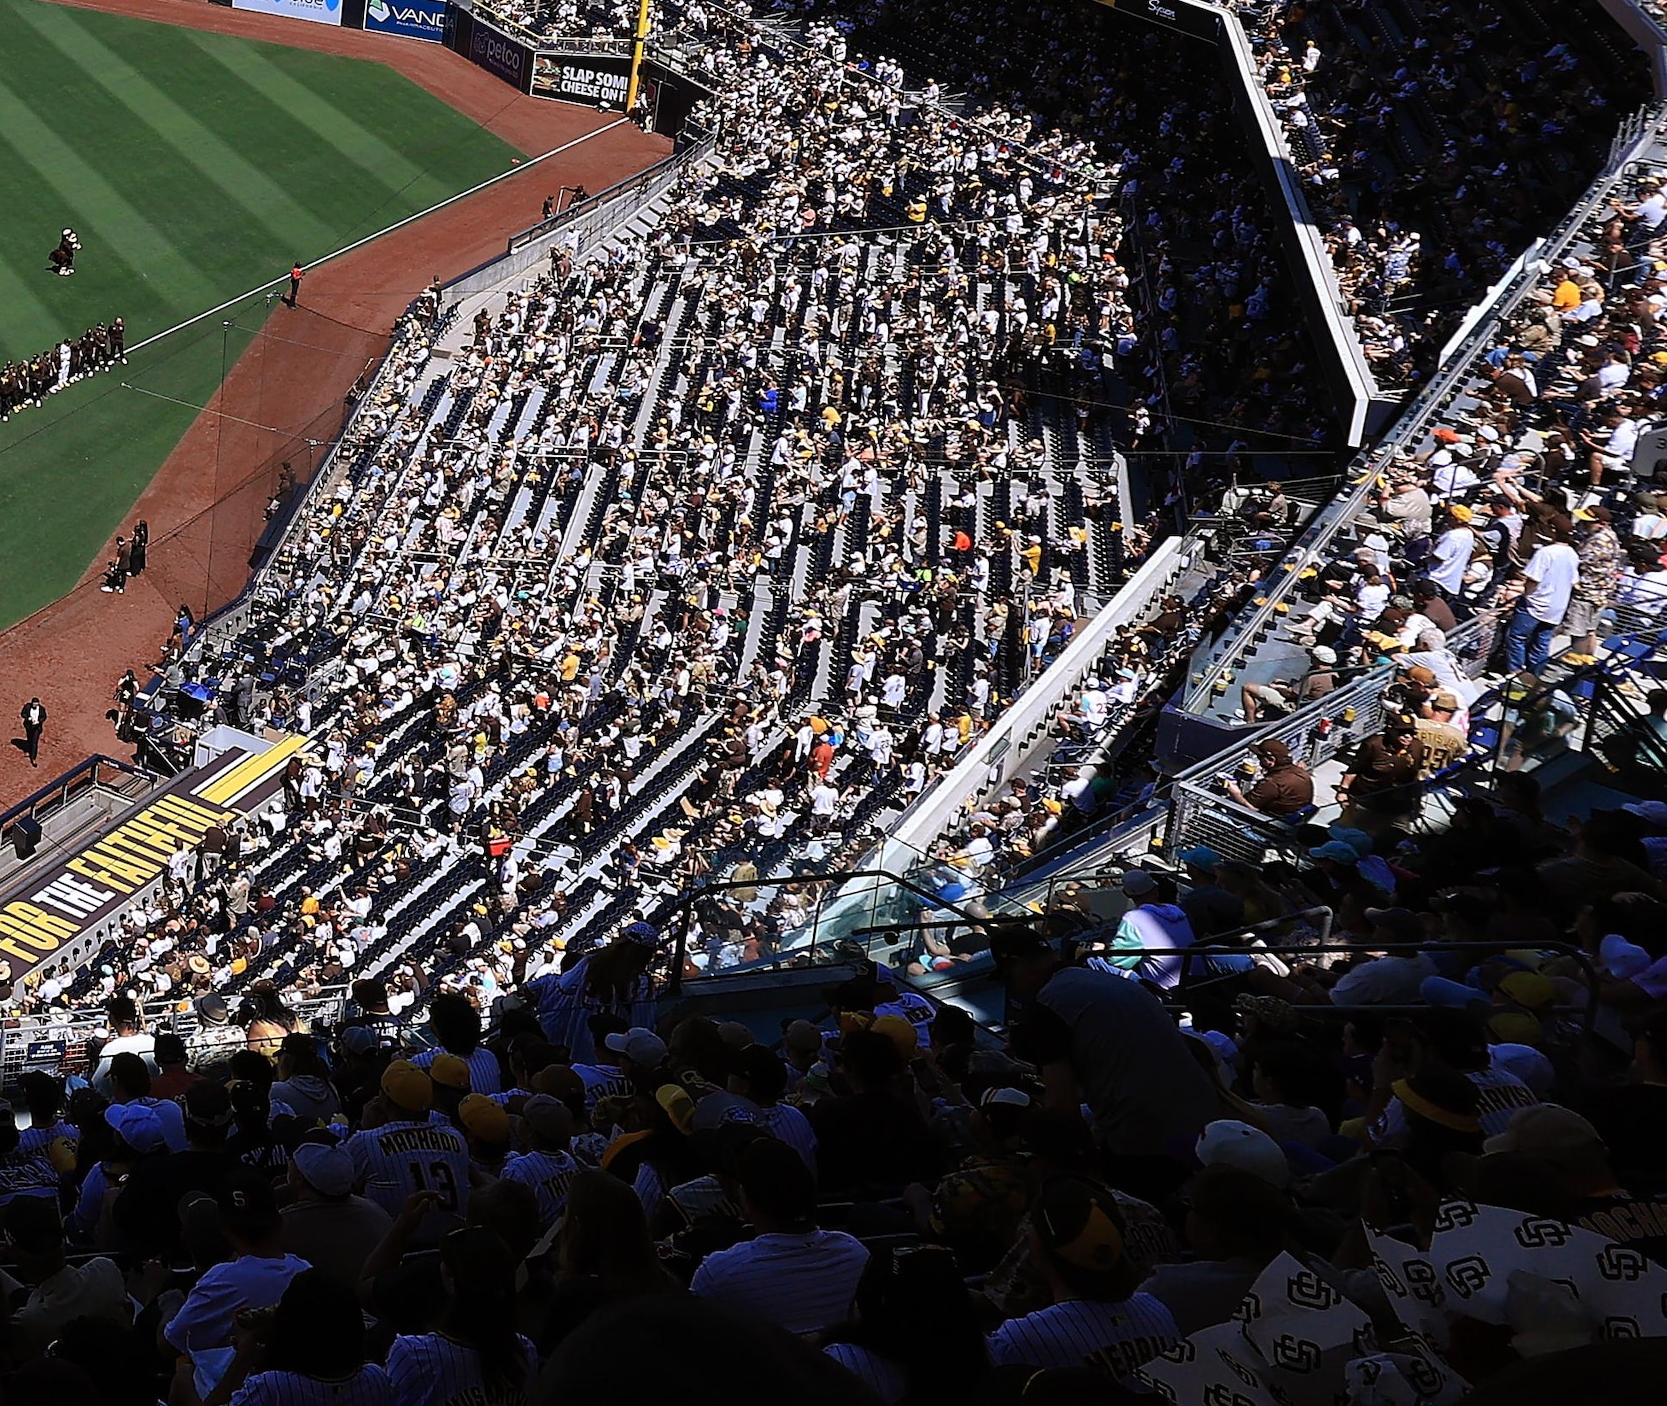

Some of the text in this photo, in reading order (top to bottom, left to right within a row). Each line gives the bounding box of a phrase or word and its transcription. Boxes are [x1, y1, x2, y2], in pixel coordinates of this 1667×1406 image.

[487, 40, 520, 72] petco
[562, 66, 594, 85] SLAP
[561, 81, 618, 101] CHEESE ON
[30, 873, 117, 920] THE
[379, 1132, 462, 1156] MACHADO
[409, 1160, 459, 1211] 13
